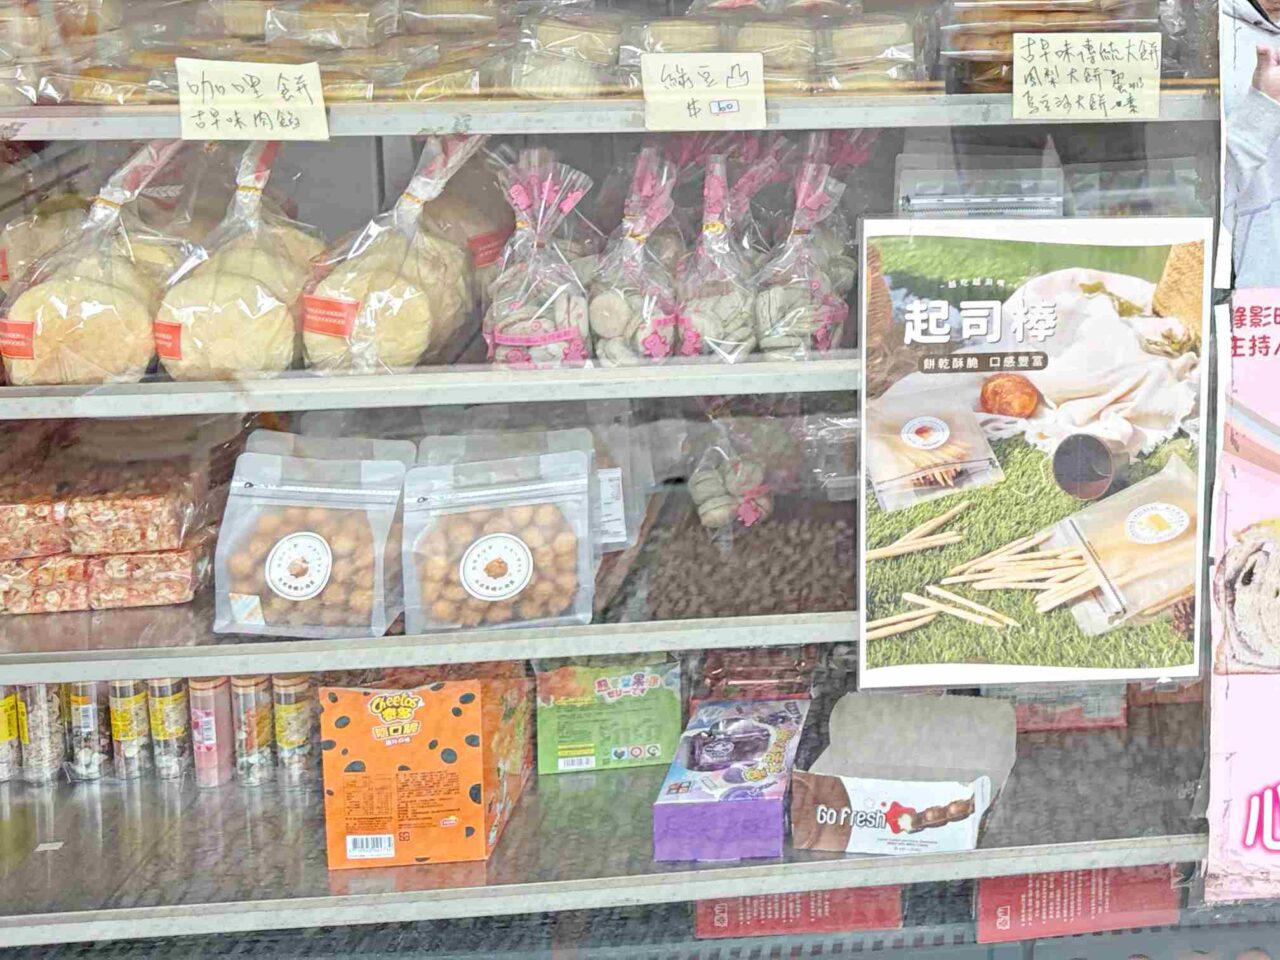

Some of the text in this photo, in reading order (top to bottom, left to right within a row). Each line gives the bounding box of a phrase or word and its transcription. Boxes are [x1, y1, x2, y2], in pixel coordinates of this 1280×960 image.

[904, 298, 1059, 344] 起司棒
[923, 355, 1044, 370] 餅乾酥脆 口感豐富
[371, 692, 420, 713] Cheetos
[840, 806, 886, 829] fresh
